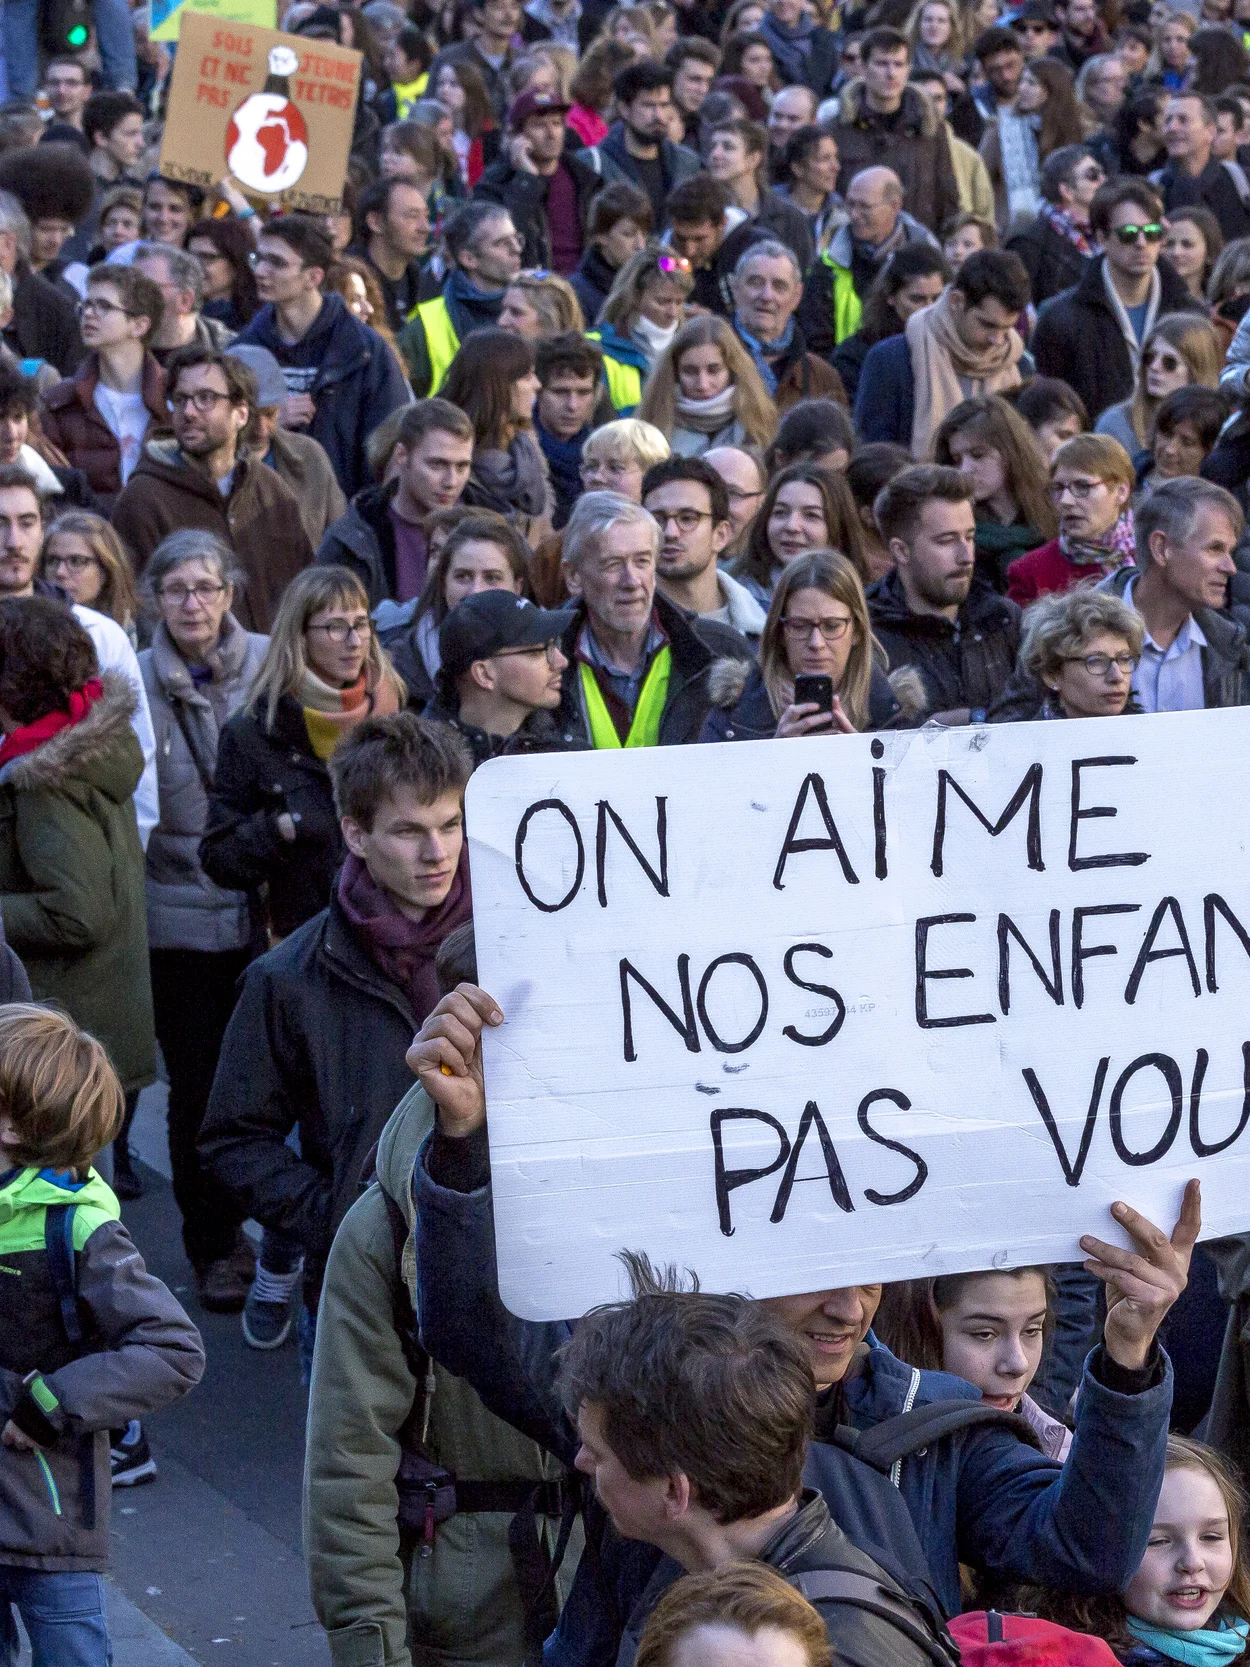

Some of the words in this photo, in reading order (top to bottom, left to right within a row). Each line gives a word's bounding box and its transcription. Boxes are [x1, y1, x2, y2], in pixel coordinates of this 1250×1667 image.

[513, 793, 671, 914] ON
[617, 939, 848, 1064] NOS
[709, 1086, 930, 1238] PAS
